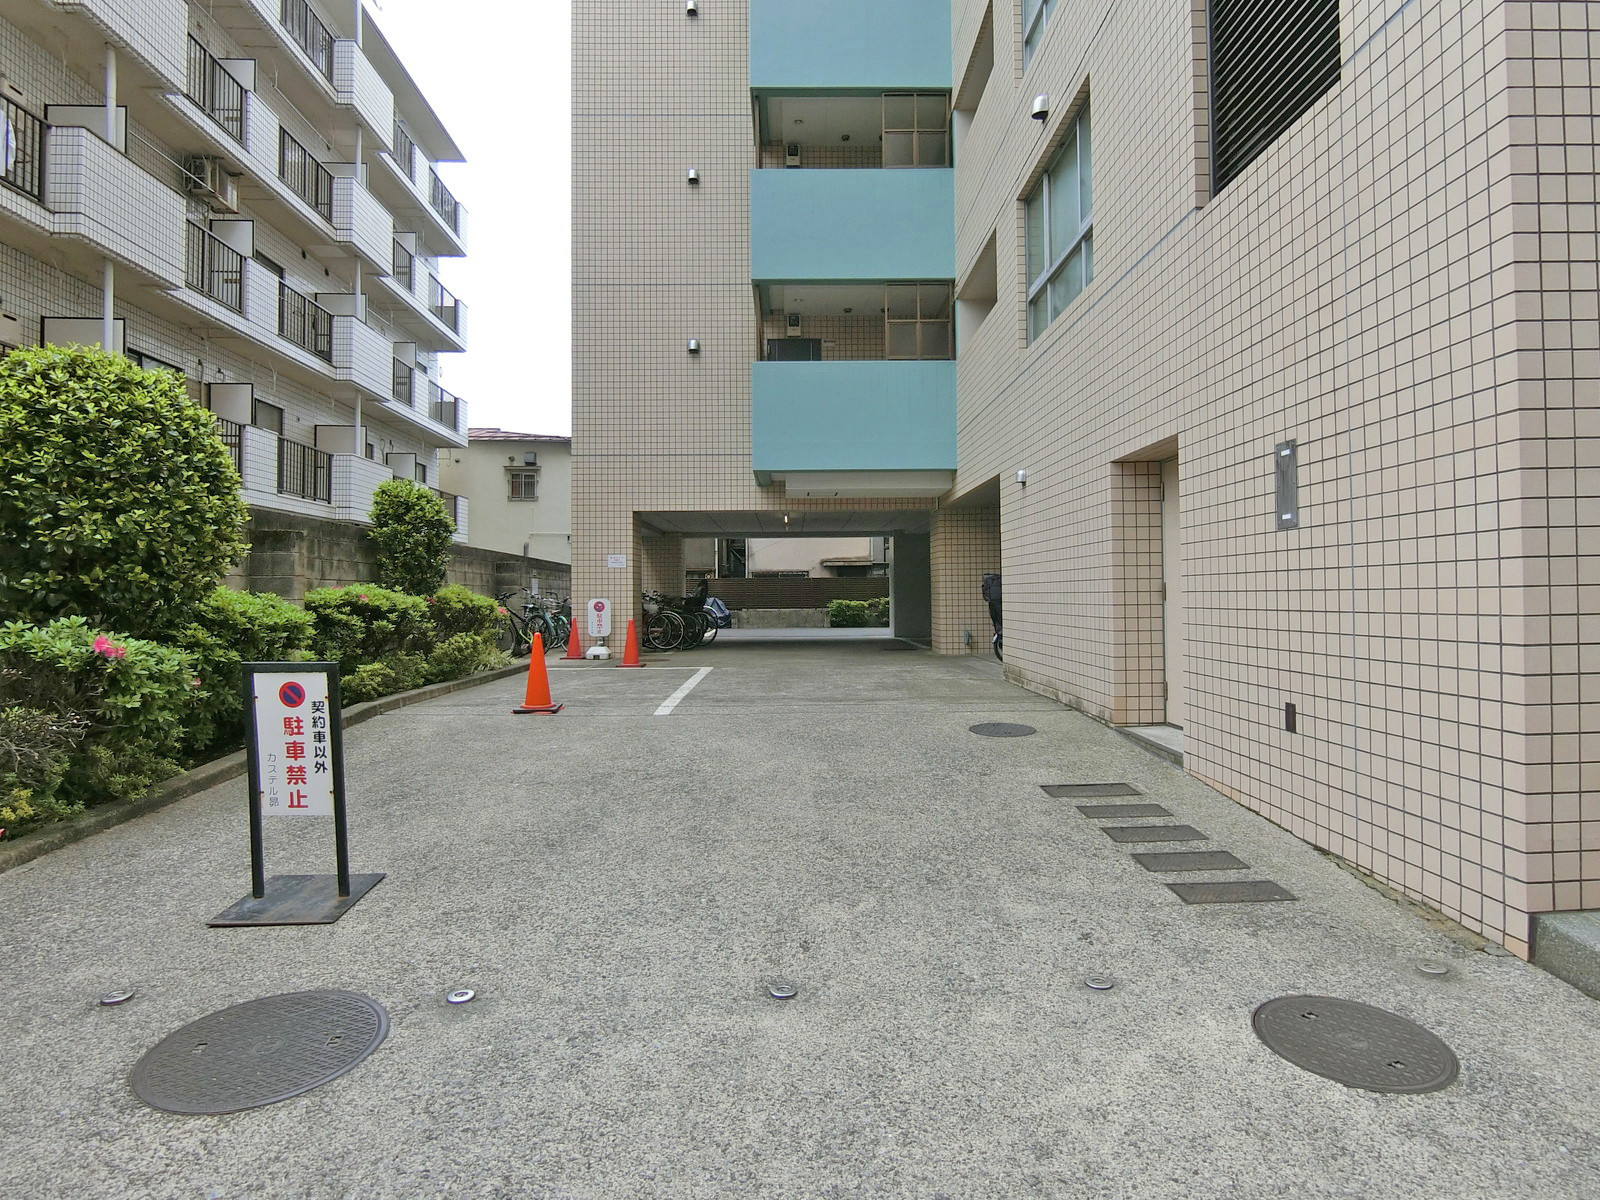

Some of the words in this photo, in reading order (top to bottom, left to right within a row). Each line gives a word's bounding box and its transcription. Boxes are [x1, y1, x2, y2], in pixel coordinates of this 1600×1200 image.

[283, 716, 308, 809] 駐車禁止
[311, 700, 328, 774] 契約車以外
